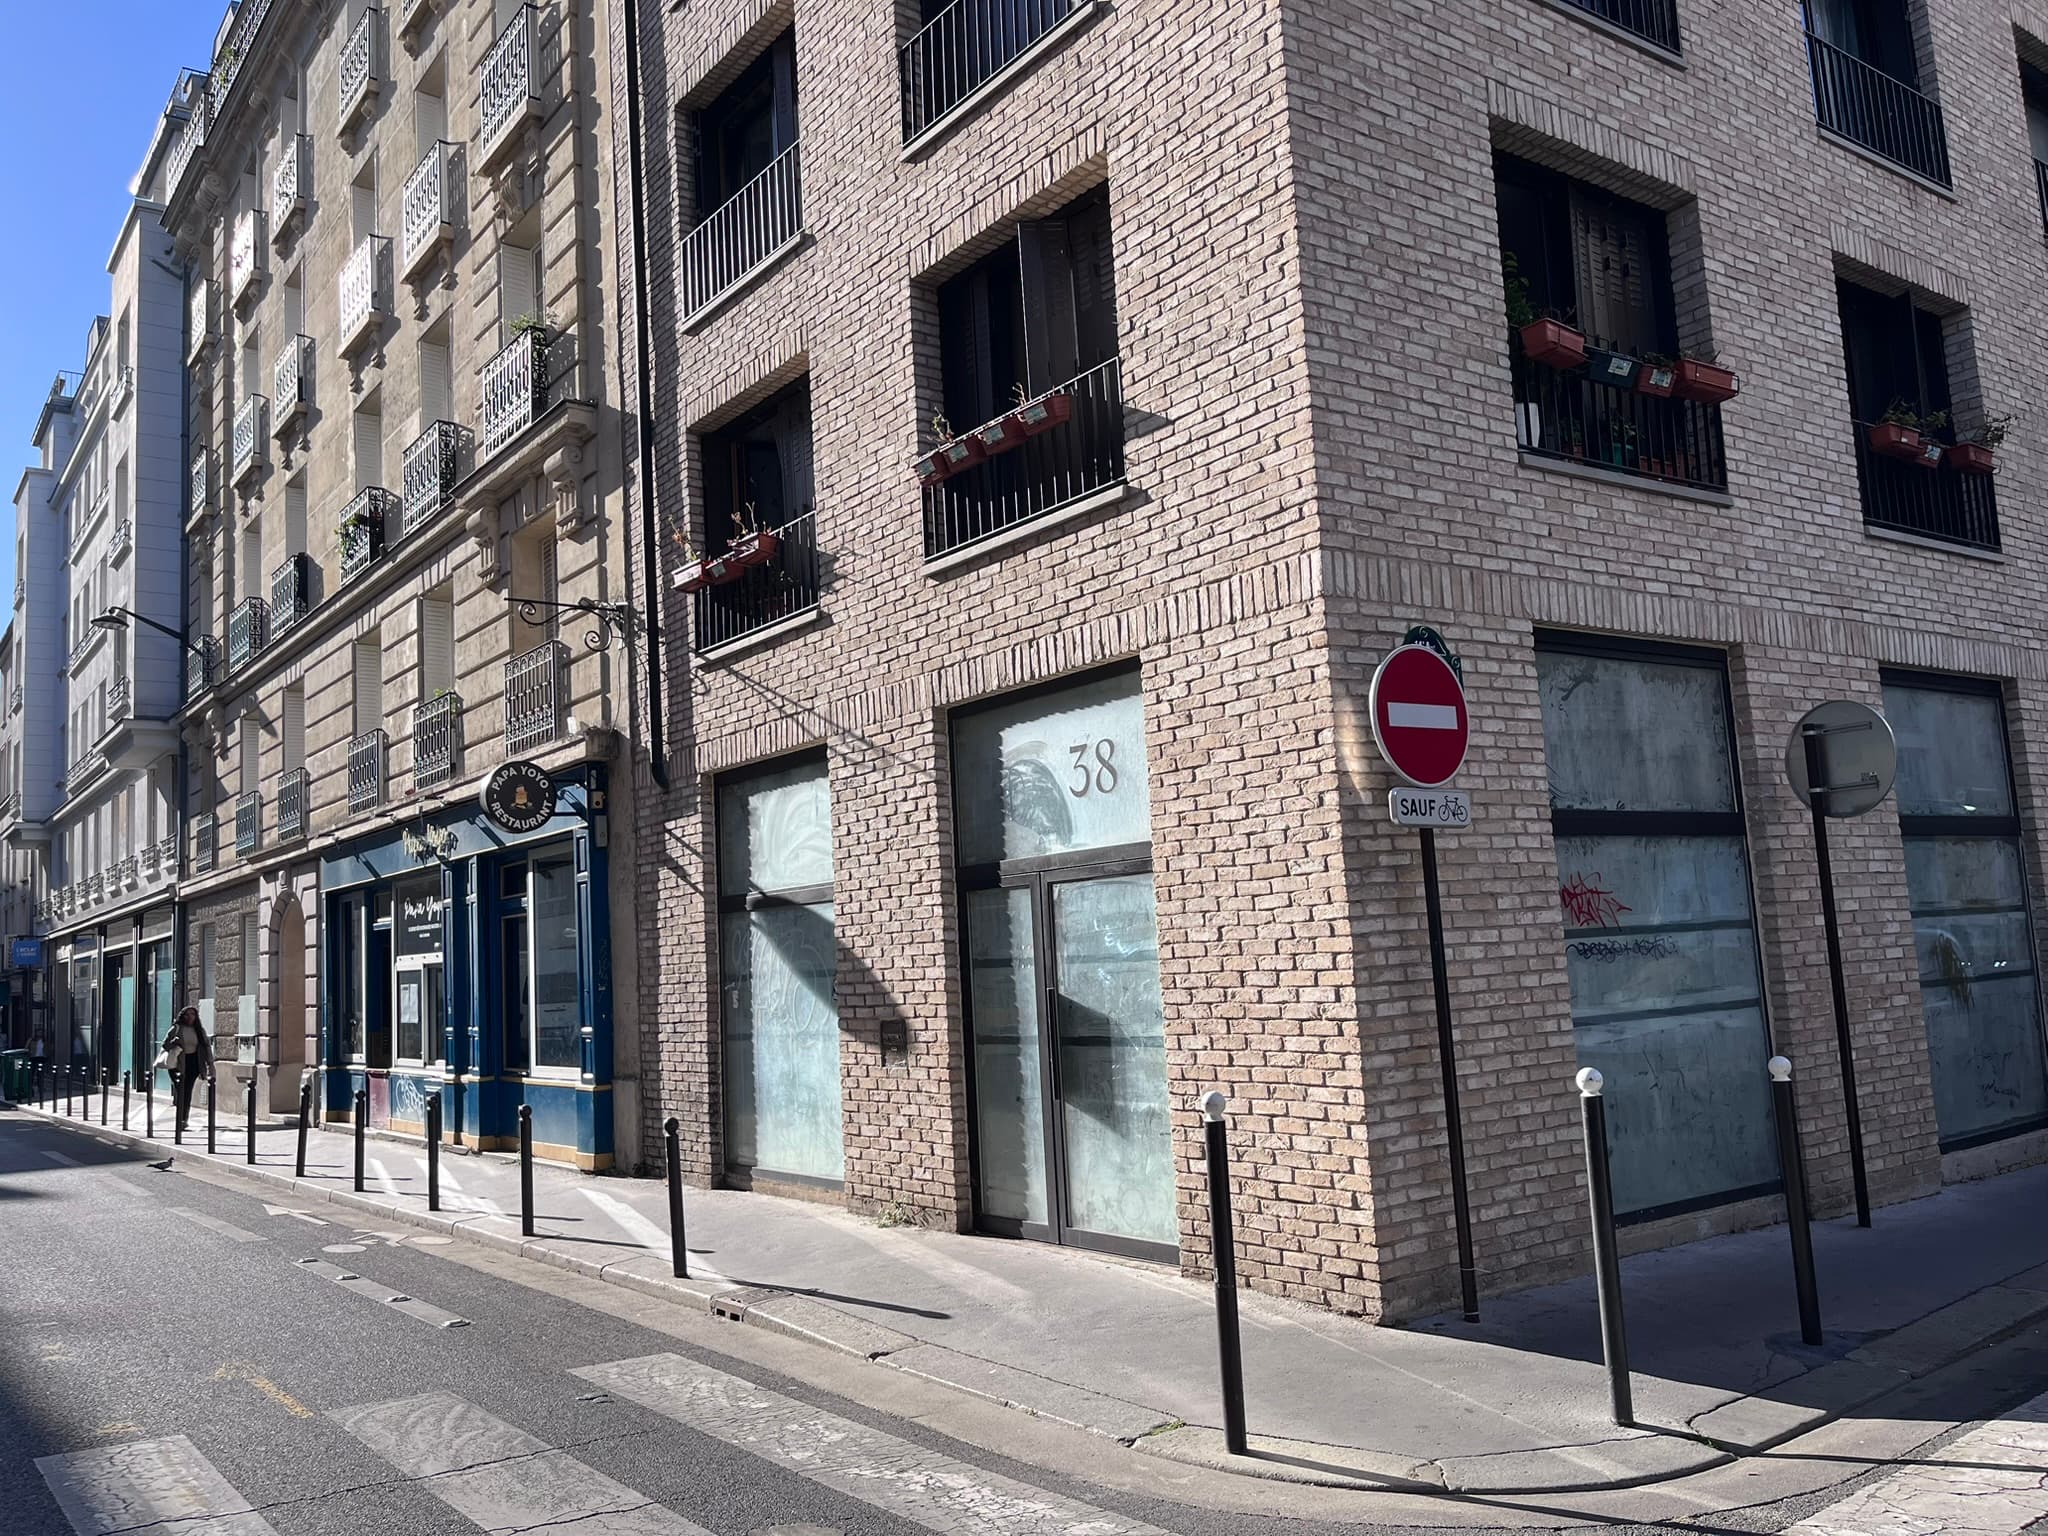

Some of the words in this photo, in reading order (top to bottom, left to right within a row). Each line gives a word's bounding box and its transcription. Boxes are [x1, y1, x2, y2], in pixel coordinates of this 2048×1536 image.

[491, 766, 518, 791] PAPA
[520, 765, 549, 789] YOYO
[1069, 738, 1118, 798] 38
[490, 799, 553, 831] RESTAURANT
[1400, 797, 1436, 817] SAUF
